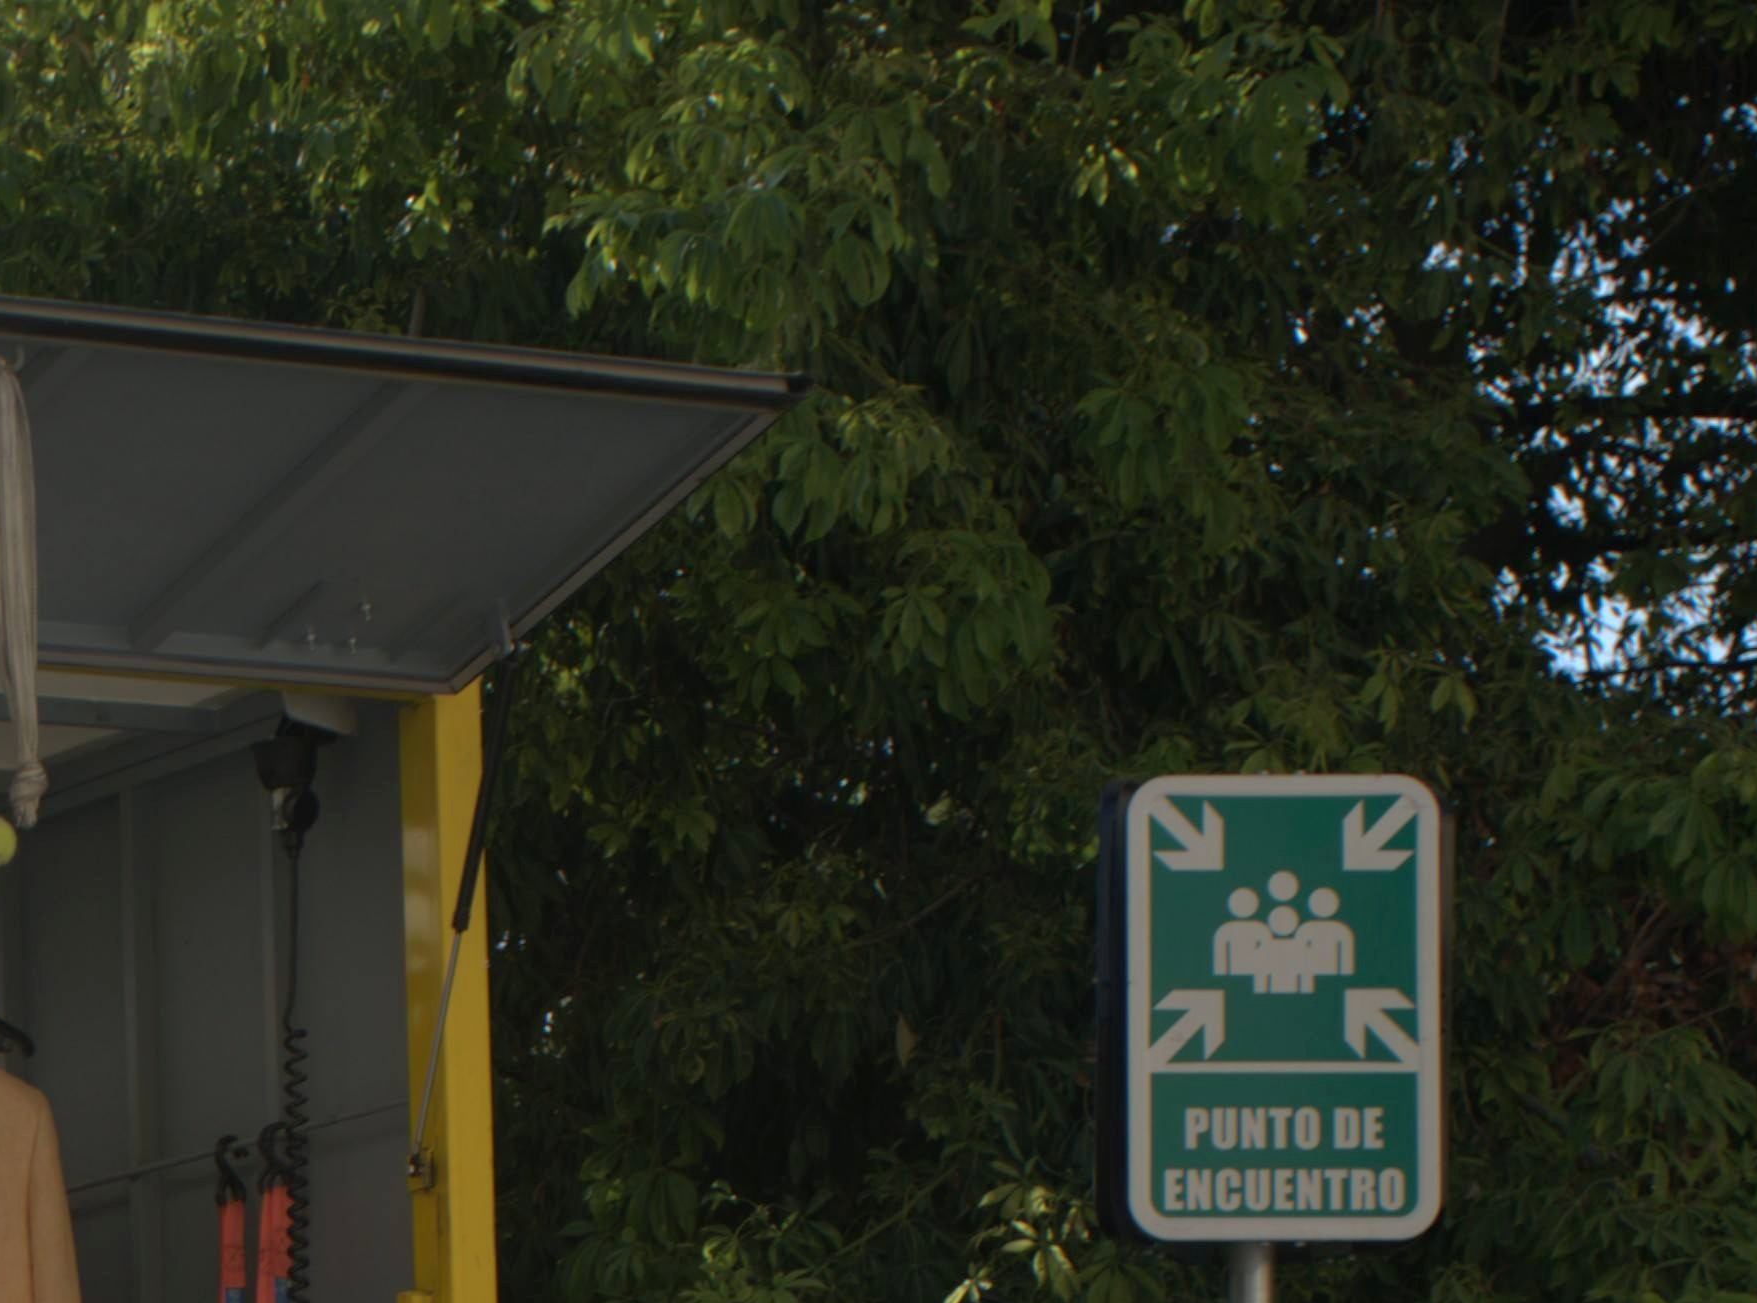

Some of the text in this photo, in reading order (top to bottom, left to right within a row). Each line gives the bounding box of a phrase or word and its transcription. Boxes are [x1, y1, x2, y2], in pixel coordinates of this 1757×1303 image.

[1184, 1106, 1384, 1151] PUNTO DE
[1163, 1168, 1406, 1212] ENCUENTRO
